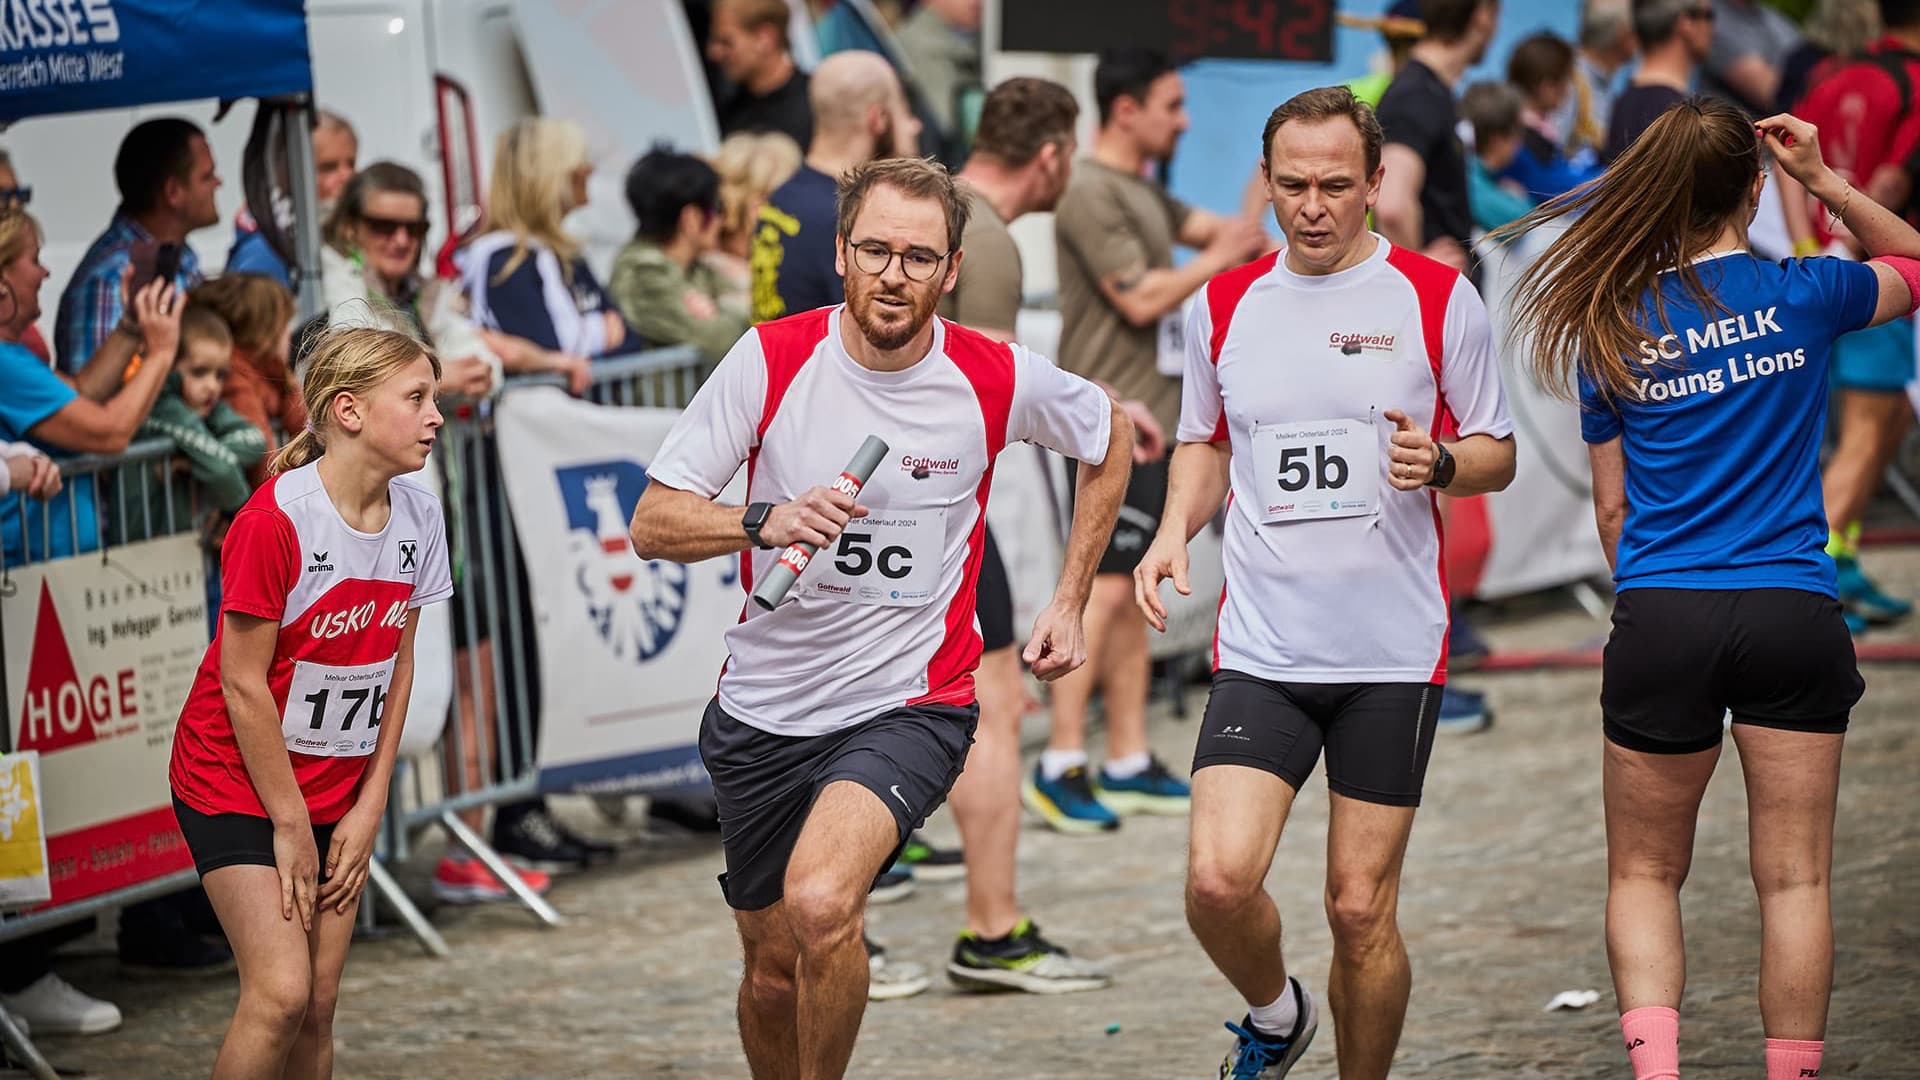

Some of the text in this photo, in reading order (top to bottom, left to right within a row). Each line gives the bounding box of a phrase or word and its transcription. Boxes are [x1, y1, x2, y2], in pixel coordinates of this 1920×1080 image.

[48, 54, 84, 84] Mitte
[87, 50, 124, 81] West
[1330, 333, 1395, 347] Gottwald
[1639, 307, 1783, 365] SC MELK
[1633, 348, 1806, 402] Young Lions
[901, 455, 959, 470] Gottwald
[1277, 445, 1349, 491] 5b
[831, 475, 859, 499] 005
[862, 518, 896, 527] Osterlauf
[898, 519, 917, 527] 2024
[308, 563, 335, 573] erima
[781, 546, 809, 570] 006
[834, 533, 913, 580] 5c
[817, 583, 852, 593] Gottwald
[311, 600, 376, 639] USKO
[324, 673, 347, 681] Melker
[348, 673, 375, 681] Osterlauf
[27, 668, 138, 742] HOGE
[304, 684, 387, 731] 17b
[295, 738, 328, 747] Gottwald
